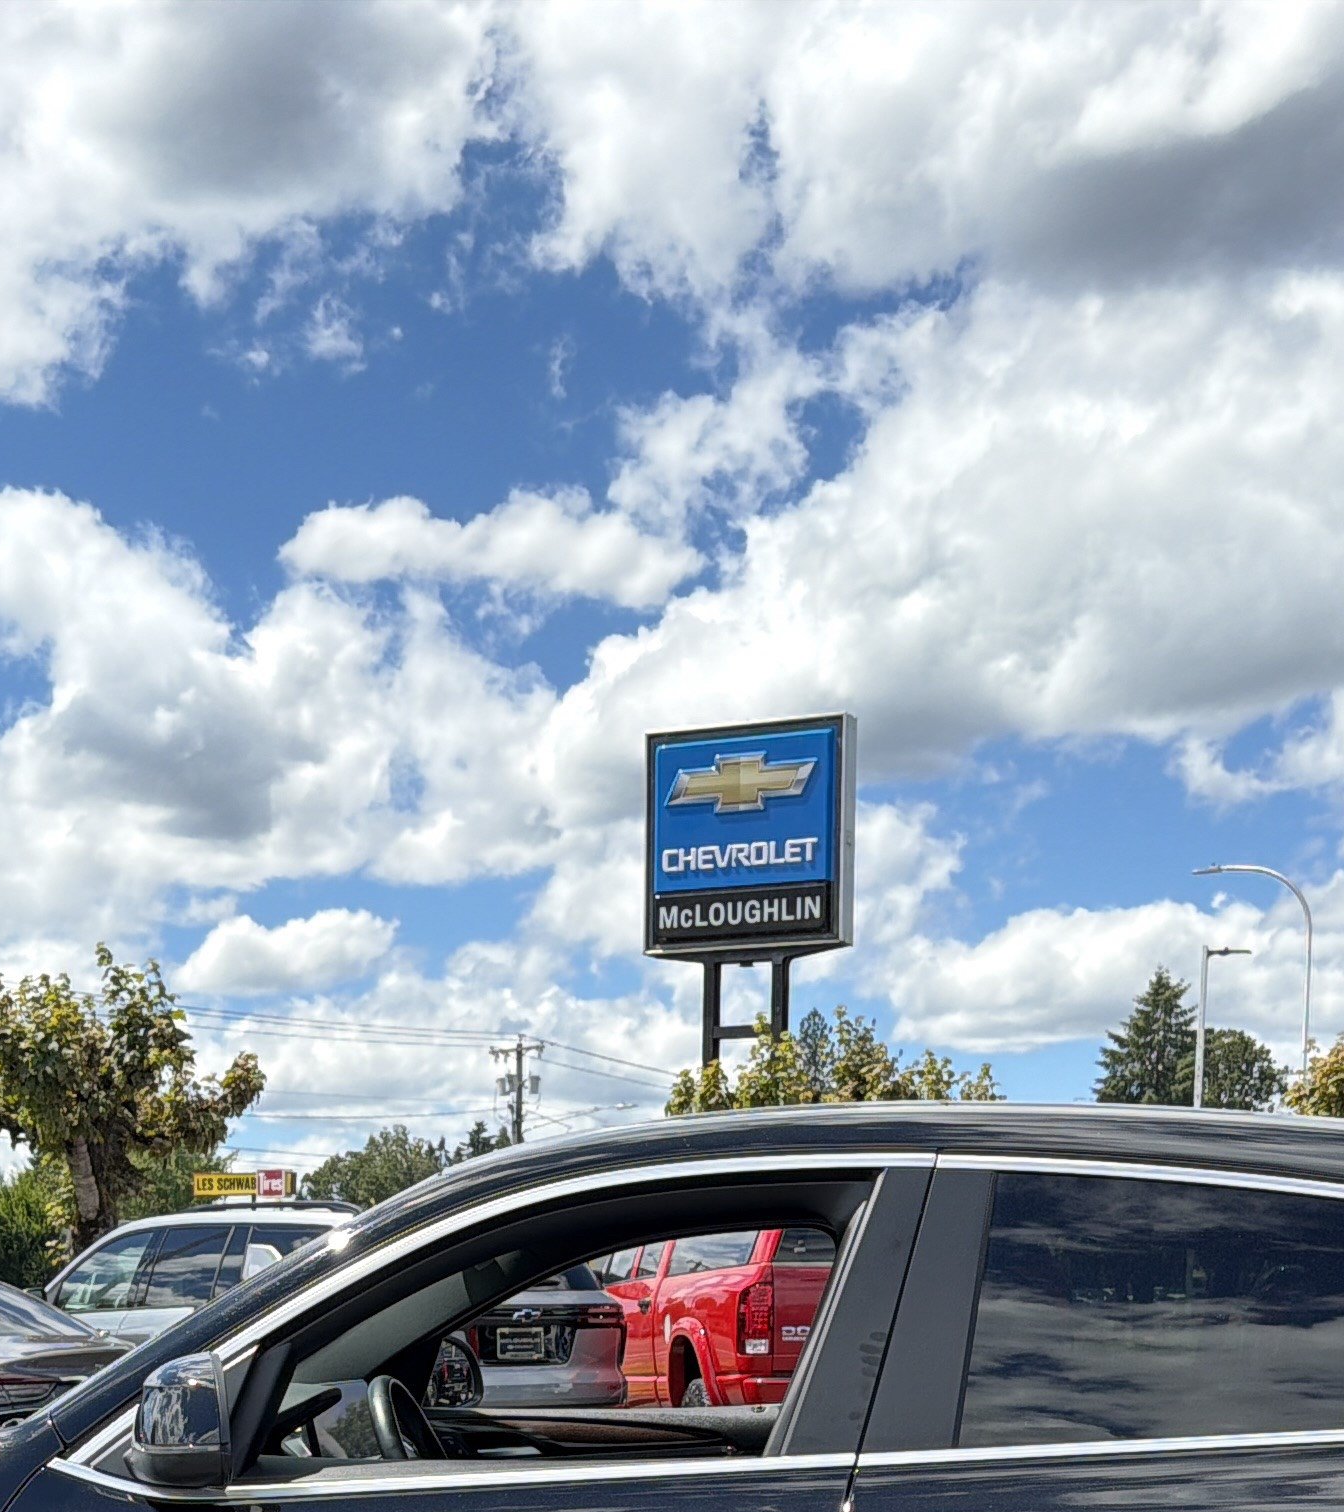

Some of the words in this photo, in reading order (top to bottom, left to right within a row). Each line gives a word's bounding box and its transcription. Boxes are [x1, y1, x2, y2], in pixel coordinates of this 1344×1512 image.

[661, 837, 819, 873] CHEVROLET
[659, 895, 822, 929] McLOUGHLIN
[197, 1178, 214, 1191] LES
[216, 1177, 257, 1191] SCHWAB
